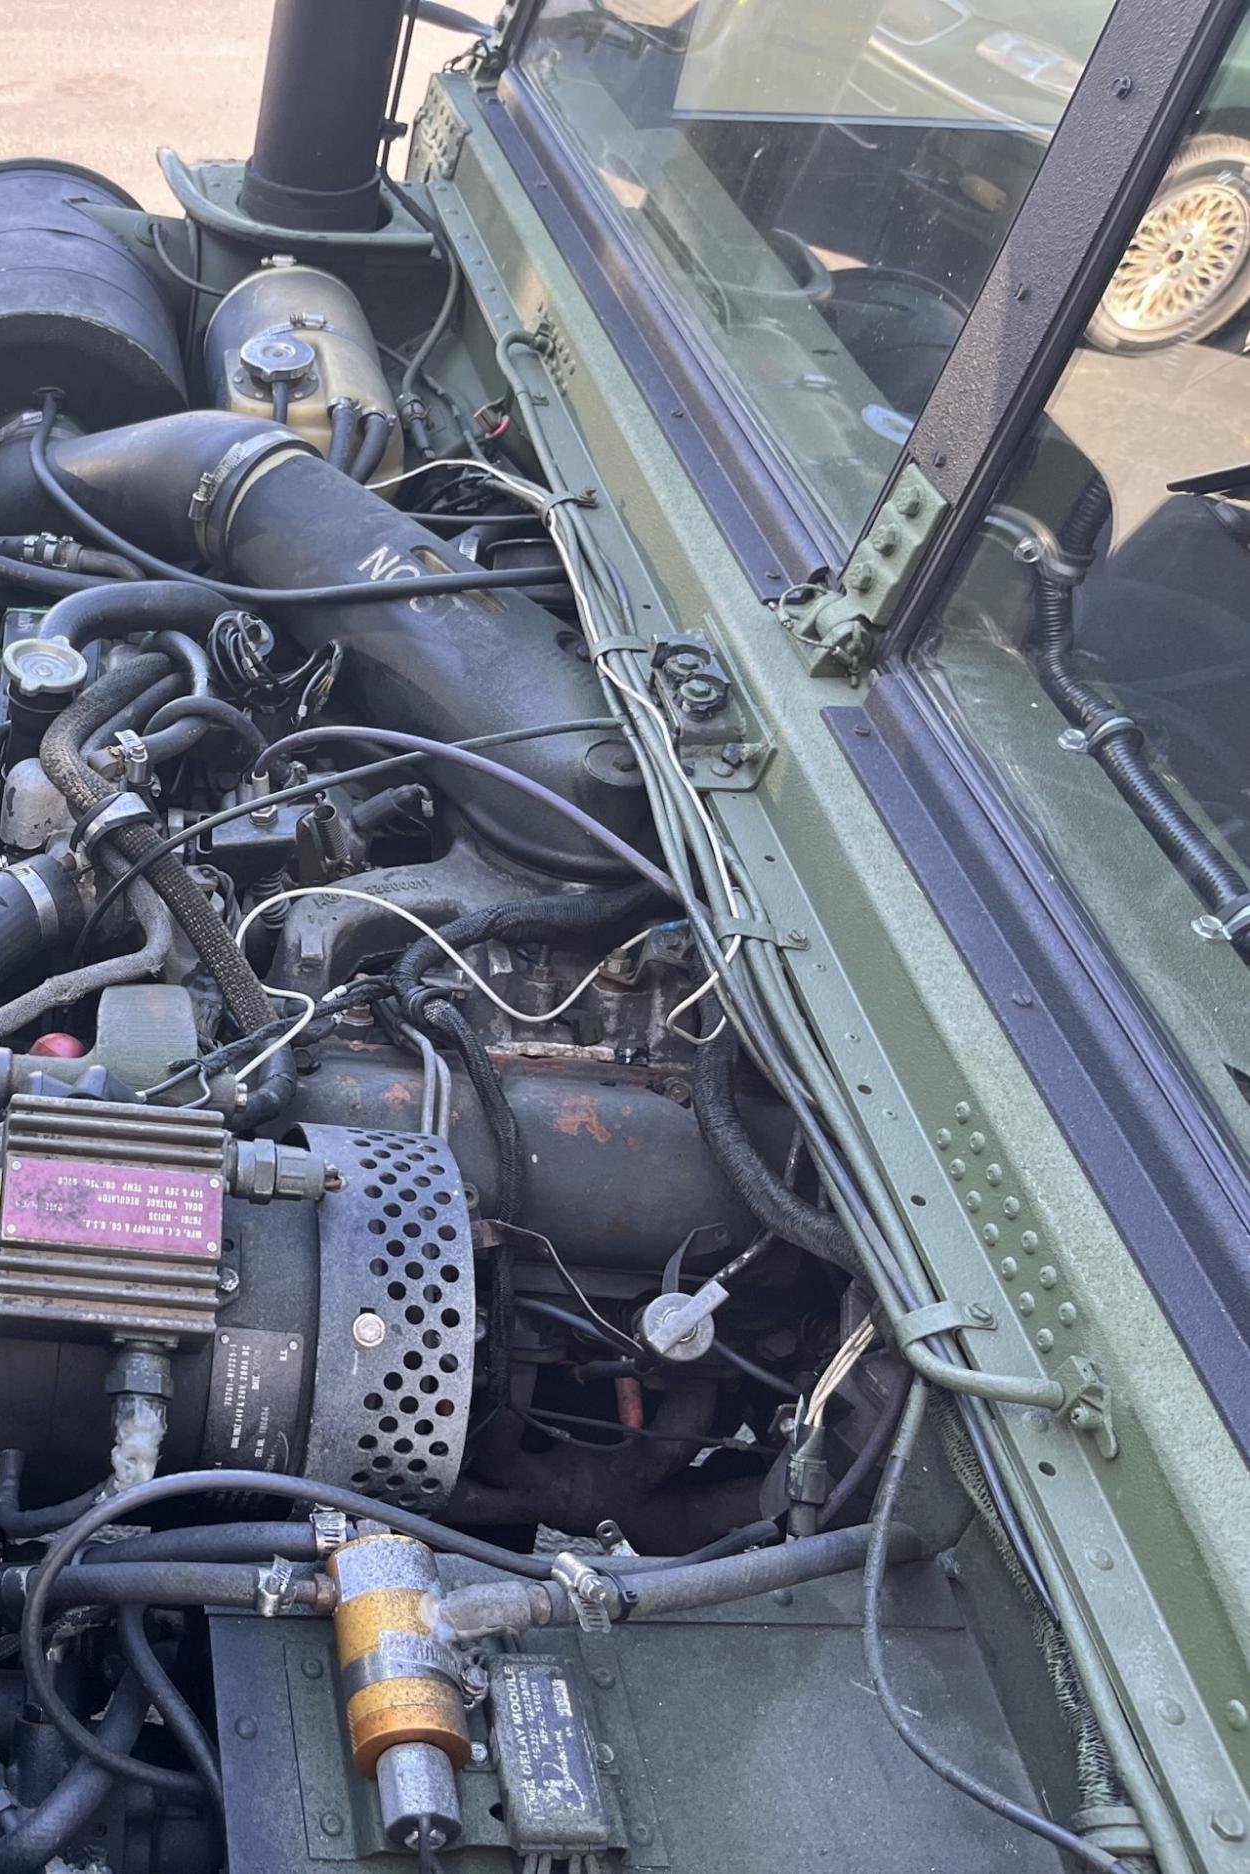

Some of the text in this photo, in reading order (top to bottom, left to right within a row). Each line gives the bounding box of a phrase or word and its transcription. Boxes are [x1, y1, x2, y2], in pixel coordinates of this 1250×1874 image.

[122, 1182, 142, 1193] TEMP
[97, 1193, 204, 1212] DUAL VOLTAGE REGULATOR
[133, 1224, 164, 1236] NIEHOFF
[183, 1228, 202, 1238] MFR.
[504, 1666, 524, 1725] MODULE
[515, 1728, 532, 1776] DELAY
